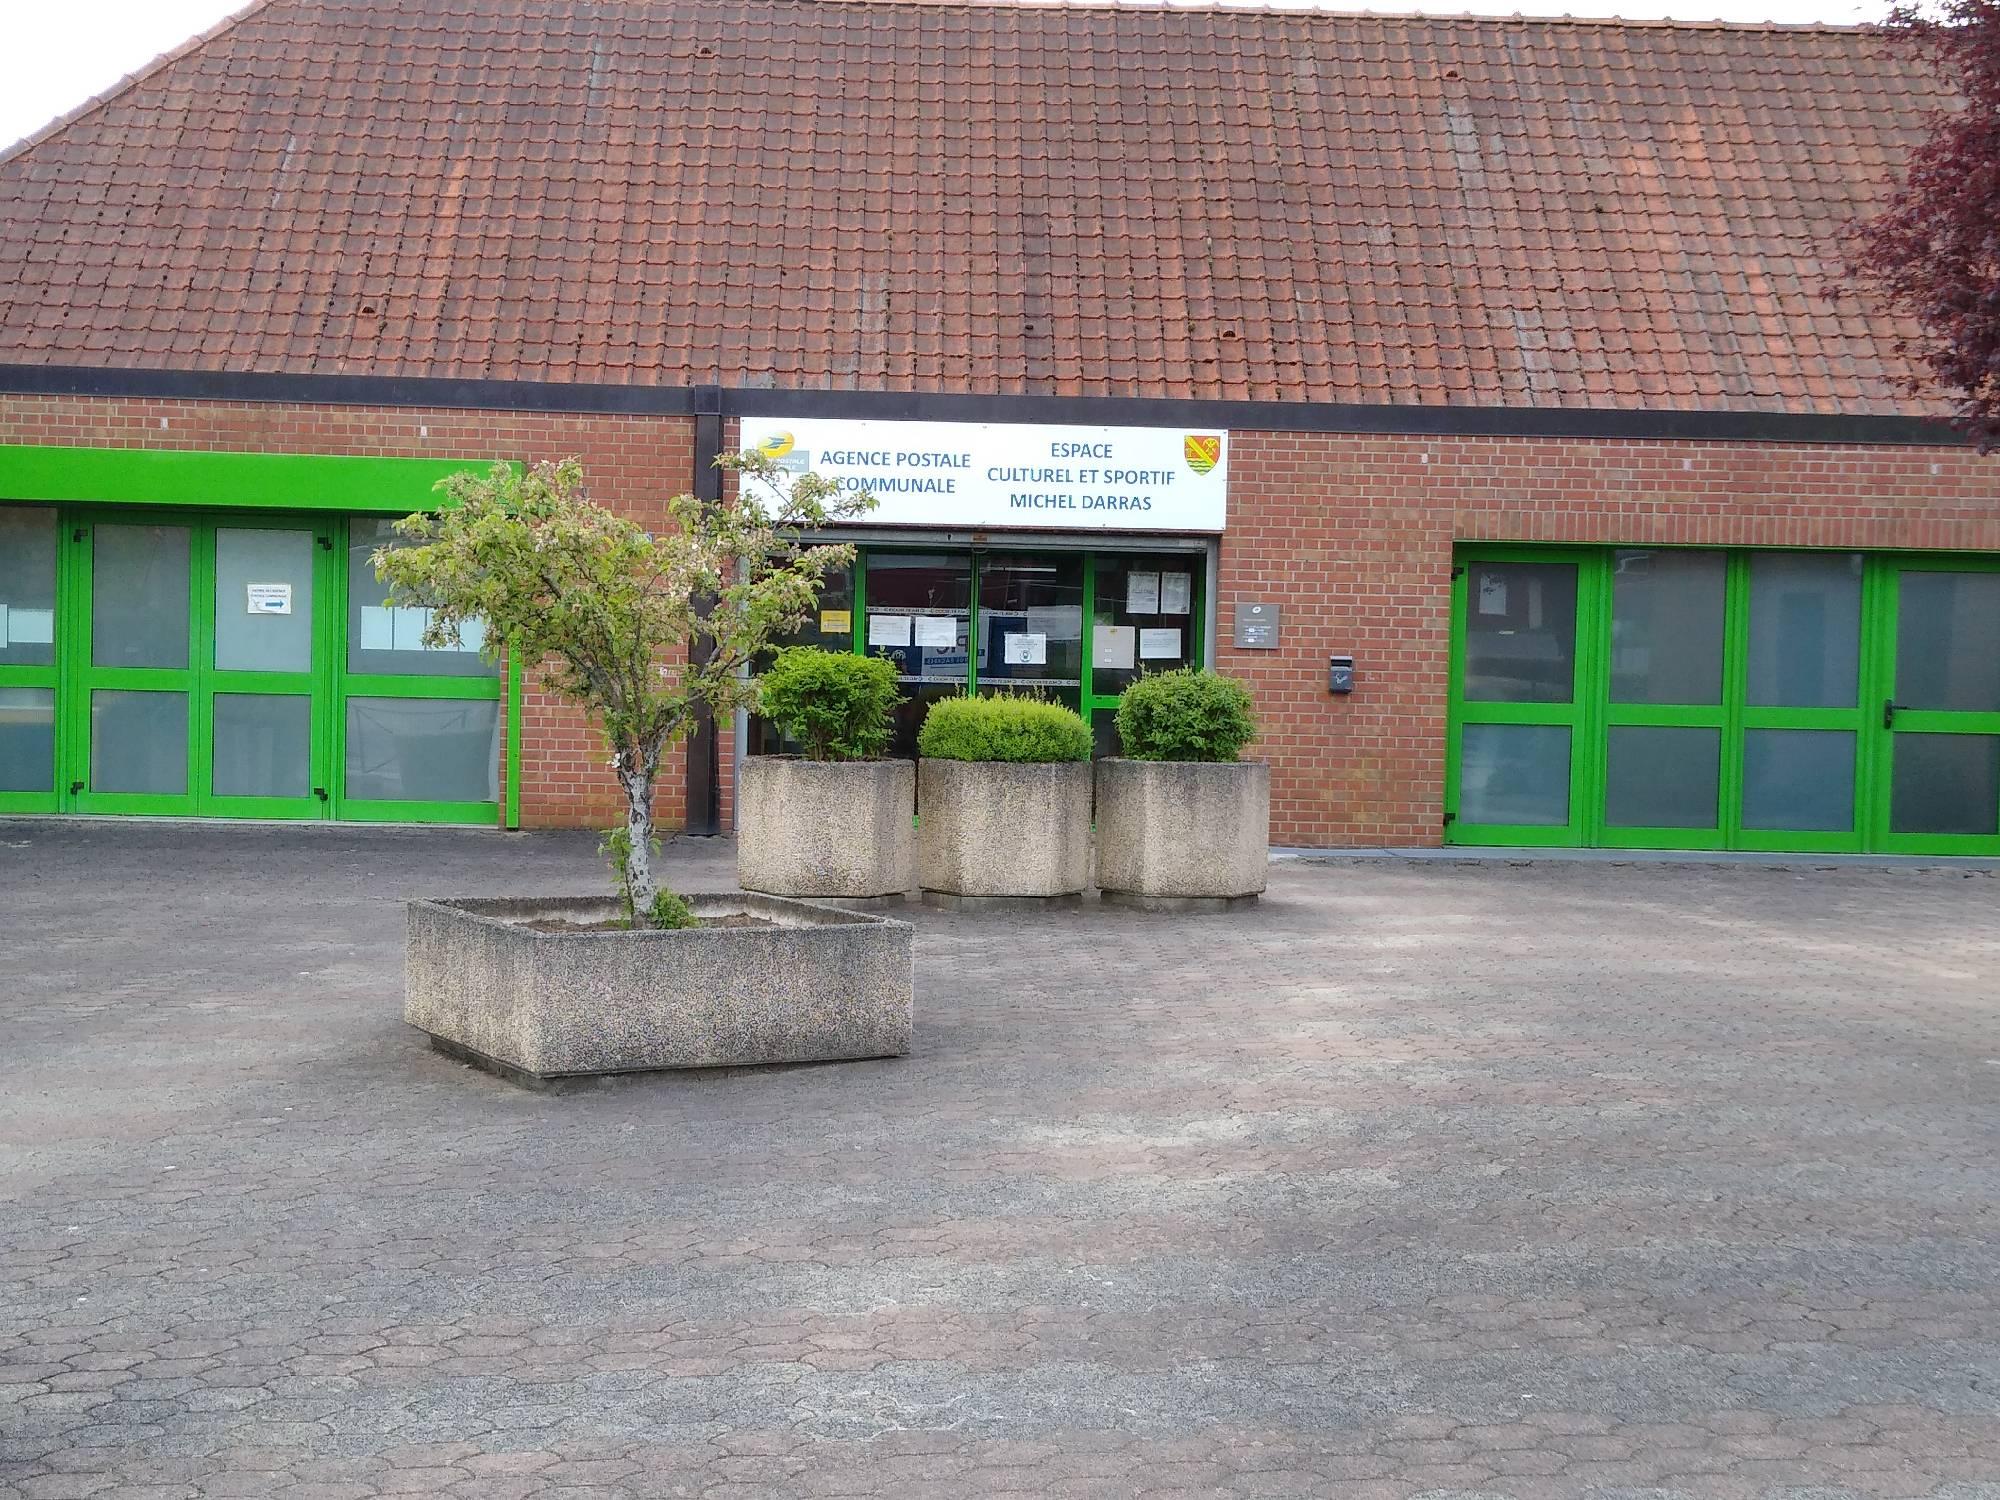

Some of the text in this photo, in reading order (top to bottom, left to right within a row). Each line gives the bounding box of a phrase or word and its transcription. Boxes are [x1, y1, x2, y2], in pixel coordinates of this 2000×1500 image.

[1051, 443, 1113, 458] ESPACE
[820, 451, 971, 468] AGENCE POSTALE
[987, 467, 1176, 485] CULTUREL ET SPORTIF
[838, 477, 956, 493] COMMUNALE
[1010, 494, 1152, 510] MICHEL DARRAS
